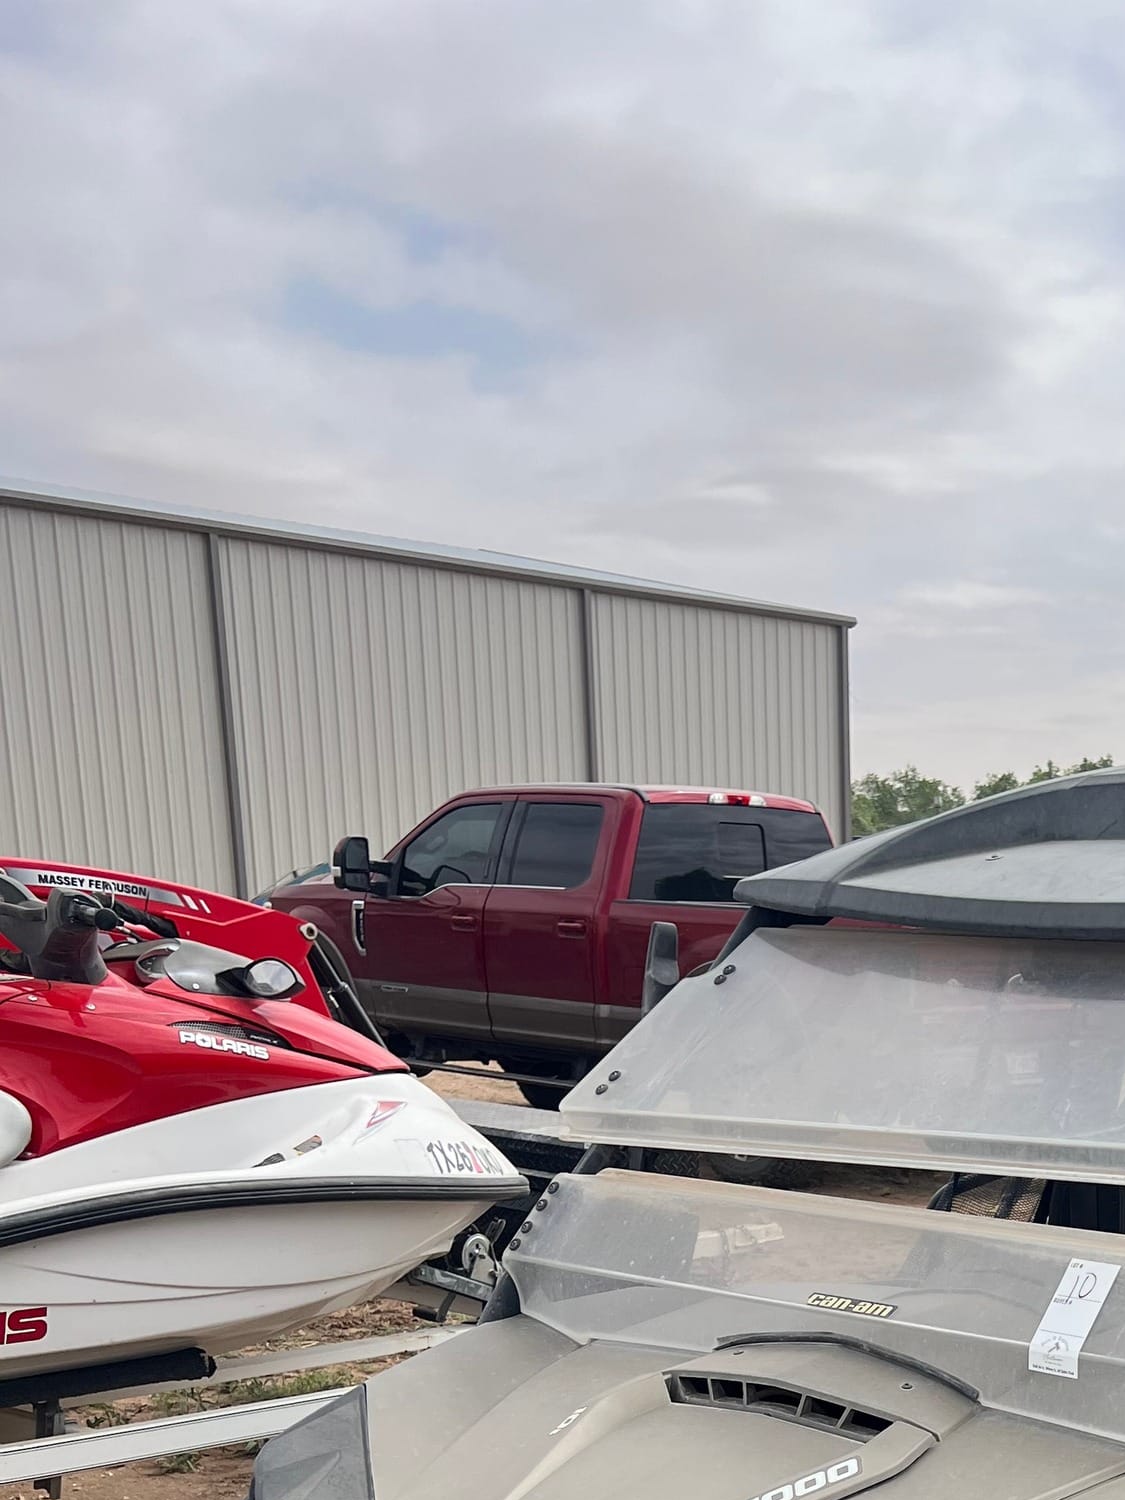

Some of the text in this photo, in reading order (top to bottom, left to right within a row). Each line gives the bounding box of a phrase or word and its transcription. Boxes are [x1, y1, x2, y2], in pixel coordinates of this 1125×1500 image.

[37, 874, 85, 888] MASSEY
[179, 1030, 270, 1060] POLARIS
[1065, 1272, 1097, 1303] 10
[807, 1293, 894, 1317] can-am
